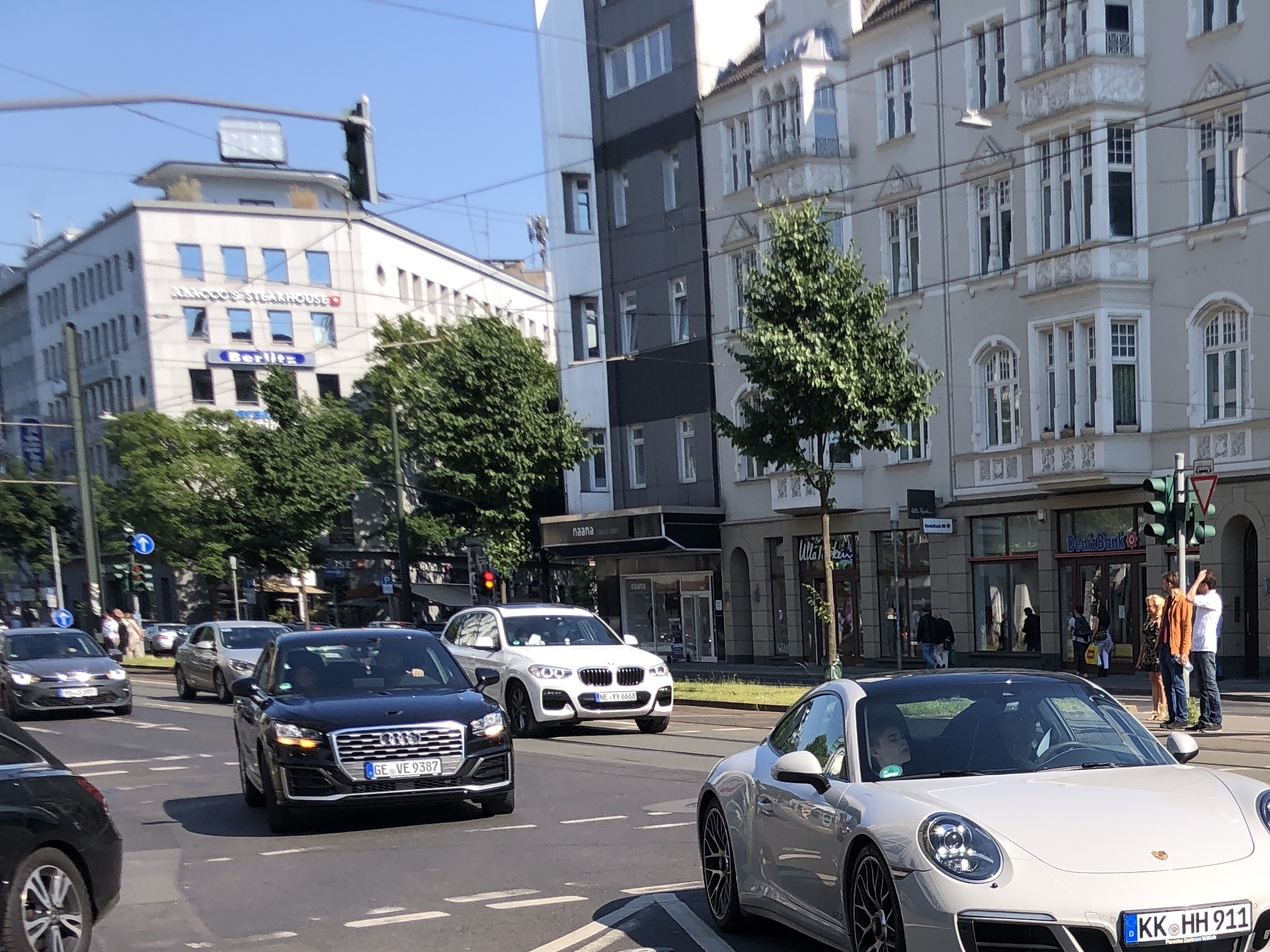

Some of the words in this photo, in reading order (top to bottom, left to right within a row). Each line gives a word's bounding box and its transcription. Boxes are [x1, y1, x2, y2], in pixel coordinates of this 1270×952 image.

[245, 291, 330, 305] STEAKHOUSE
[228, 352, 298, 365] Berlitz
[572, 525, 595, 537] naana
[1067, 531, 1126, 552] DenizBank
[374, 764, 388, 776] GE
[396, 762, 411, 774] VE
[412, 760, 439, 773] 9387
[1139, 915, 1167, 939] KK
[1182, 911, 1208, 935] HH
[1213, 907, 1249, 931] 911
